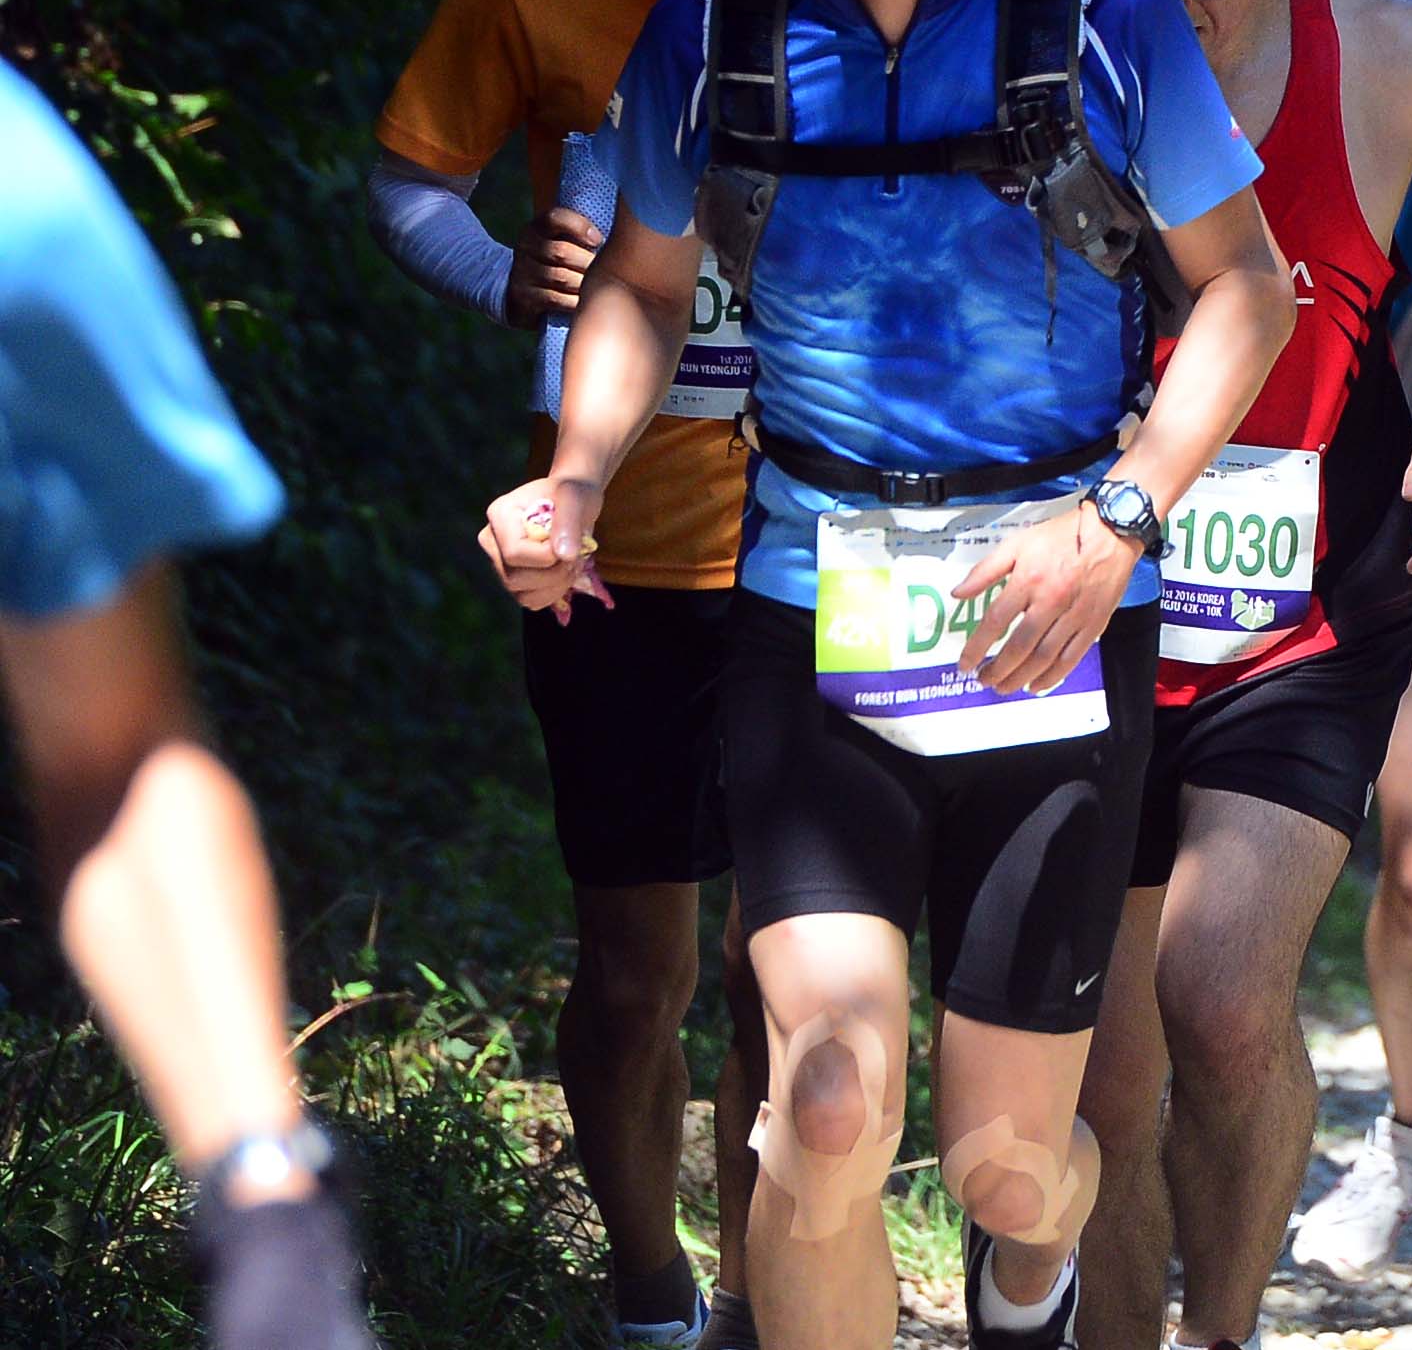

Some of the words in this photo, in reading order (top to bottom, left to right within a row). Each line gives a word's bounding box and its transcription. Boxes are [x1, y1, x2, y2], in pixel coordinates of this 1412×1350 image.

[700, 364, 741, 376] YEONGJU
[1174, 589, 1197, 603] 2016
[1197, 592, 1226, 607] KOREA
[1182, 602, 1200, 615] 42K
[1206, 605, 1223, 618] 10K
[855, 690, 895, 706] FOREST
